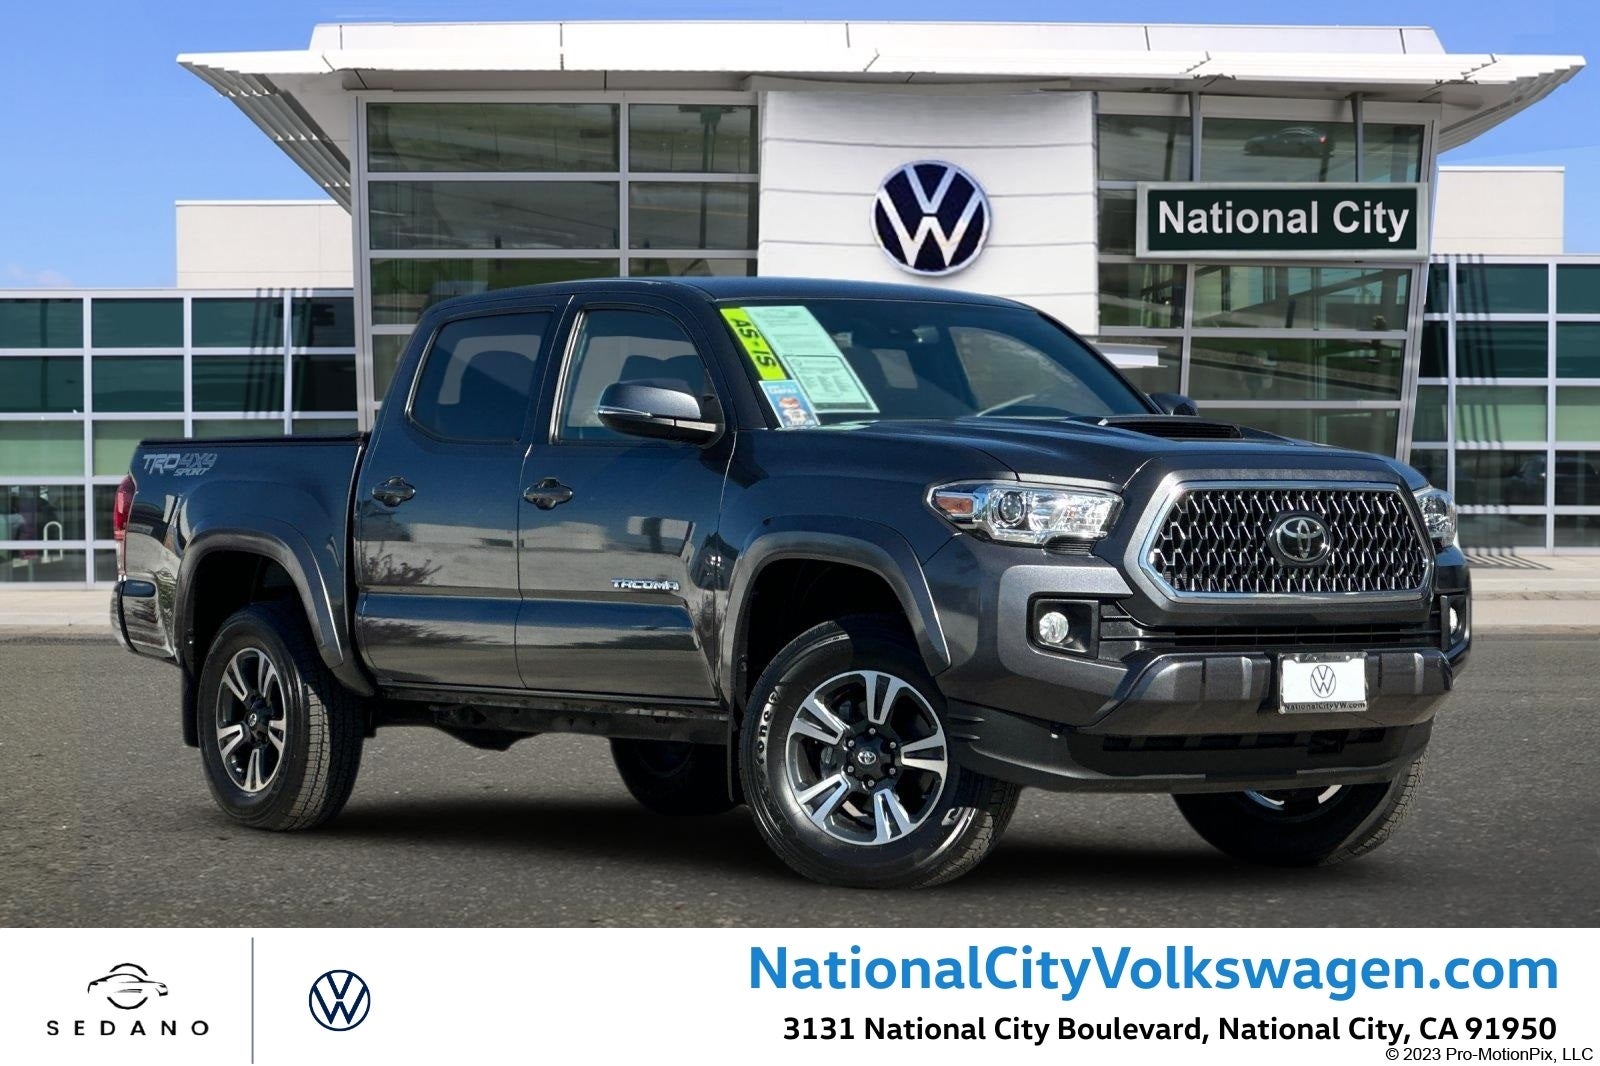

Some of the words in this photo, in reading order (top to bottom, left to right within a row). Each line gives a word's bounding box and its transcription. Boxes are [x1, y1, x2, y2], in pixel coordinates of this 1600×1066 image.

[1159, 200, 1318, 234] National
[1333, 200, 1410, 243] City
[143, 453, 181, 475] TRD
[173, 467, 211, 477] SPORT
[611, 578, 680, 591] TACOMA
[1285, 701, 1366, 711] NationalCityVW.com
